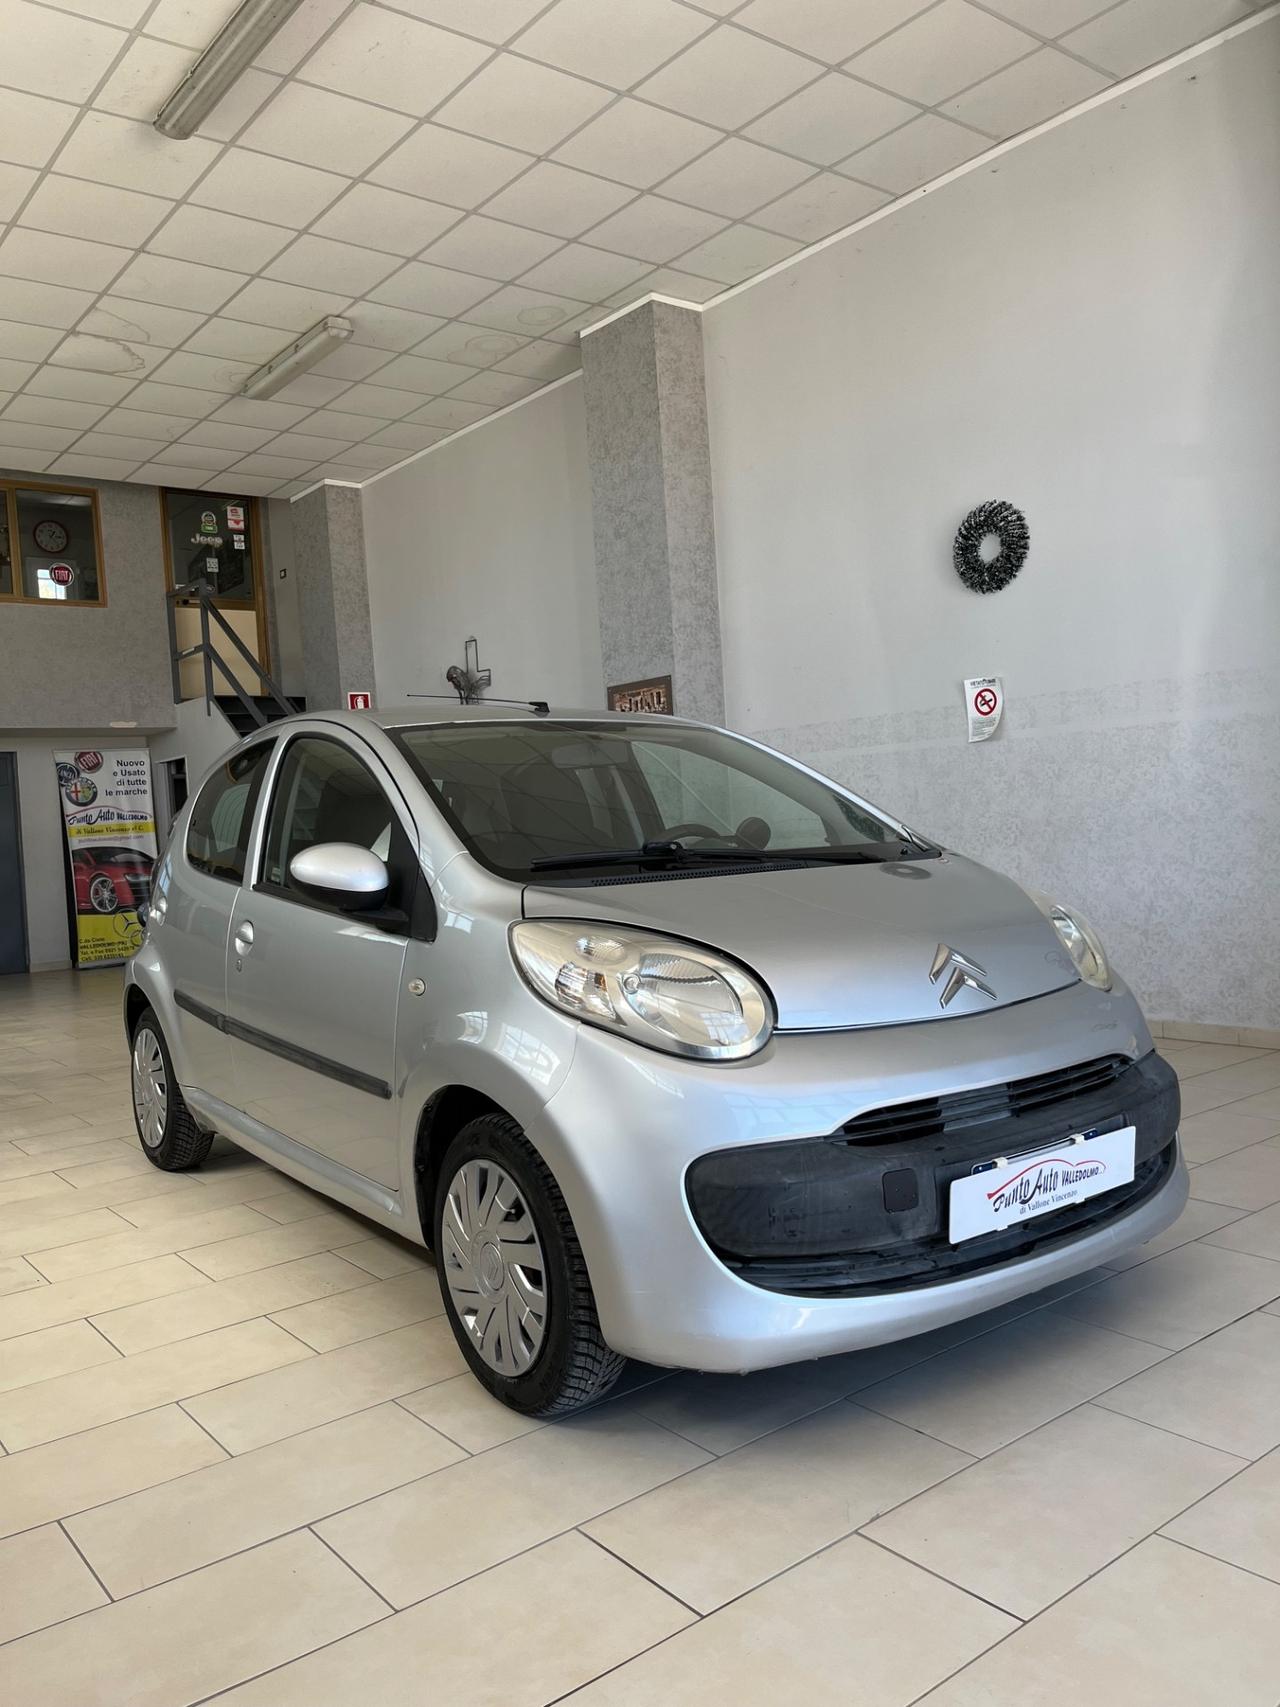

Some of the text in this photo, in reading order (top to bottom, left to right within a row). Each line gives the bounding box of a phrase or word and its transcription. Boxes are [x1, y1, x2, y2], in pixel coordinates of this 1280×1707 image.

[191, 533, 223, 548] Jeep
[55, 569, 69, 581] FIAT
[80, 752, 98, 769] FIAT
[120, 769, 146, 777] Usato
[115, 788, 148, 796] marche
[993, 1167, 1099, 1212] Punto Auto VALLEDOLMO
[1028, 1200, 1050, 1211] Vallone
[1051, 1190, 1078, 1203] Vincenzo
